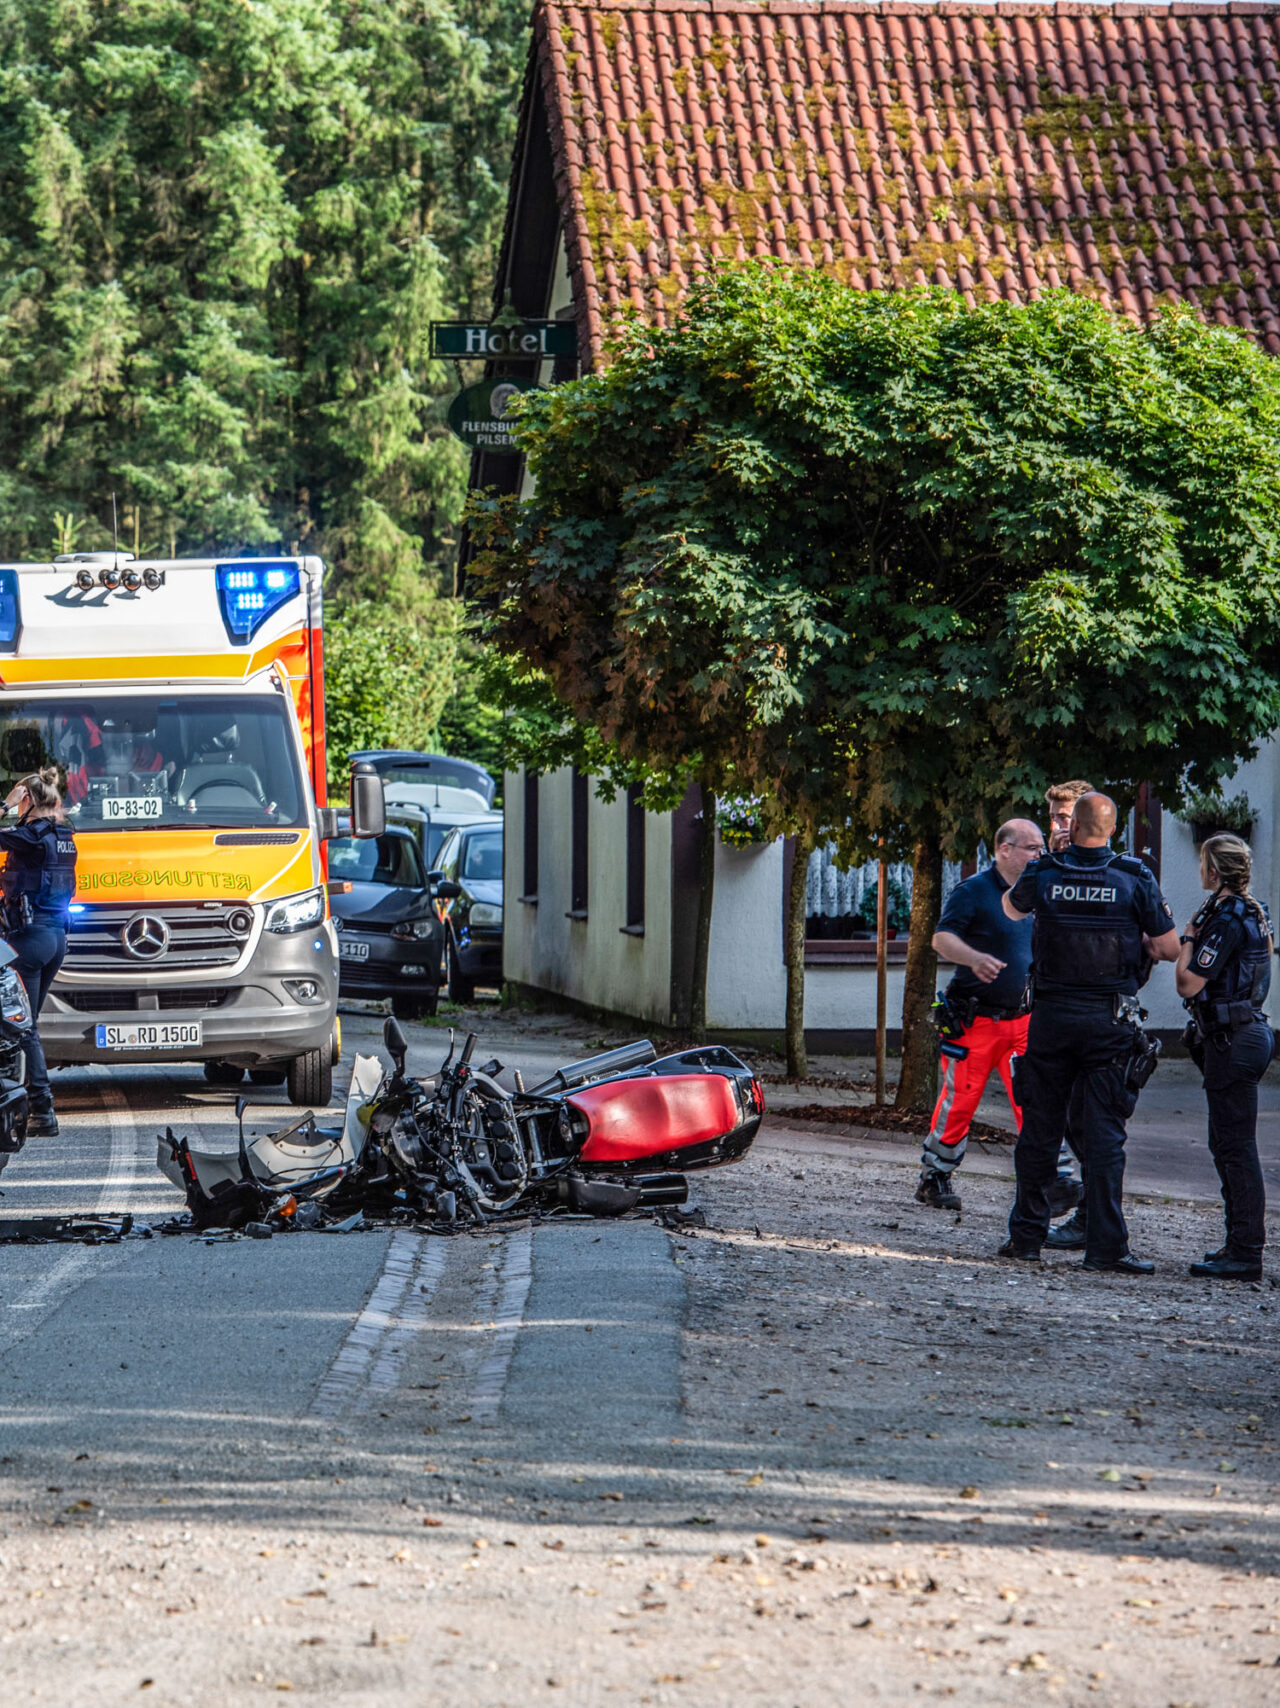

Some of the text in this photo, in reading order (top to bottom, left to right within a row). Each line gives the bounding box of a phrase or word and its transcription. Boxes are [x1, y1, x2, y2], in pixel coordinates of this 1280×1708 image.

[465, 328, 547, 353] Hotel
[462, 421, 520, 433] FLENSBU
[477, 433, 520, 445] PILSEN
[107, 800, 158, 817] 10-83-02
[1051, 884, 1117, 903] POLIZEI
[107, 1025, 198, 1044] SL RD 1500
